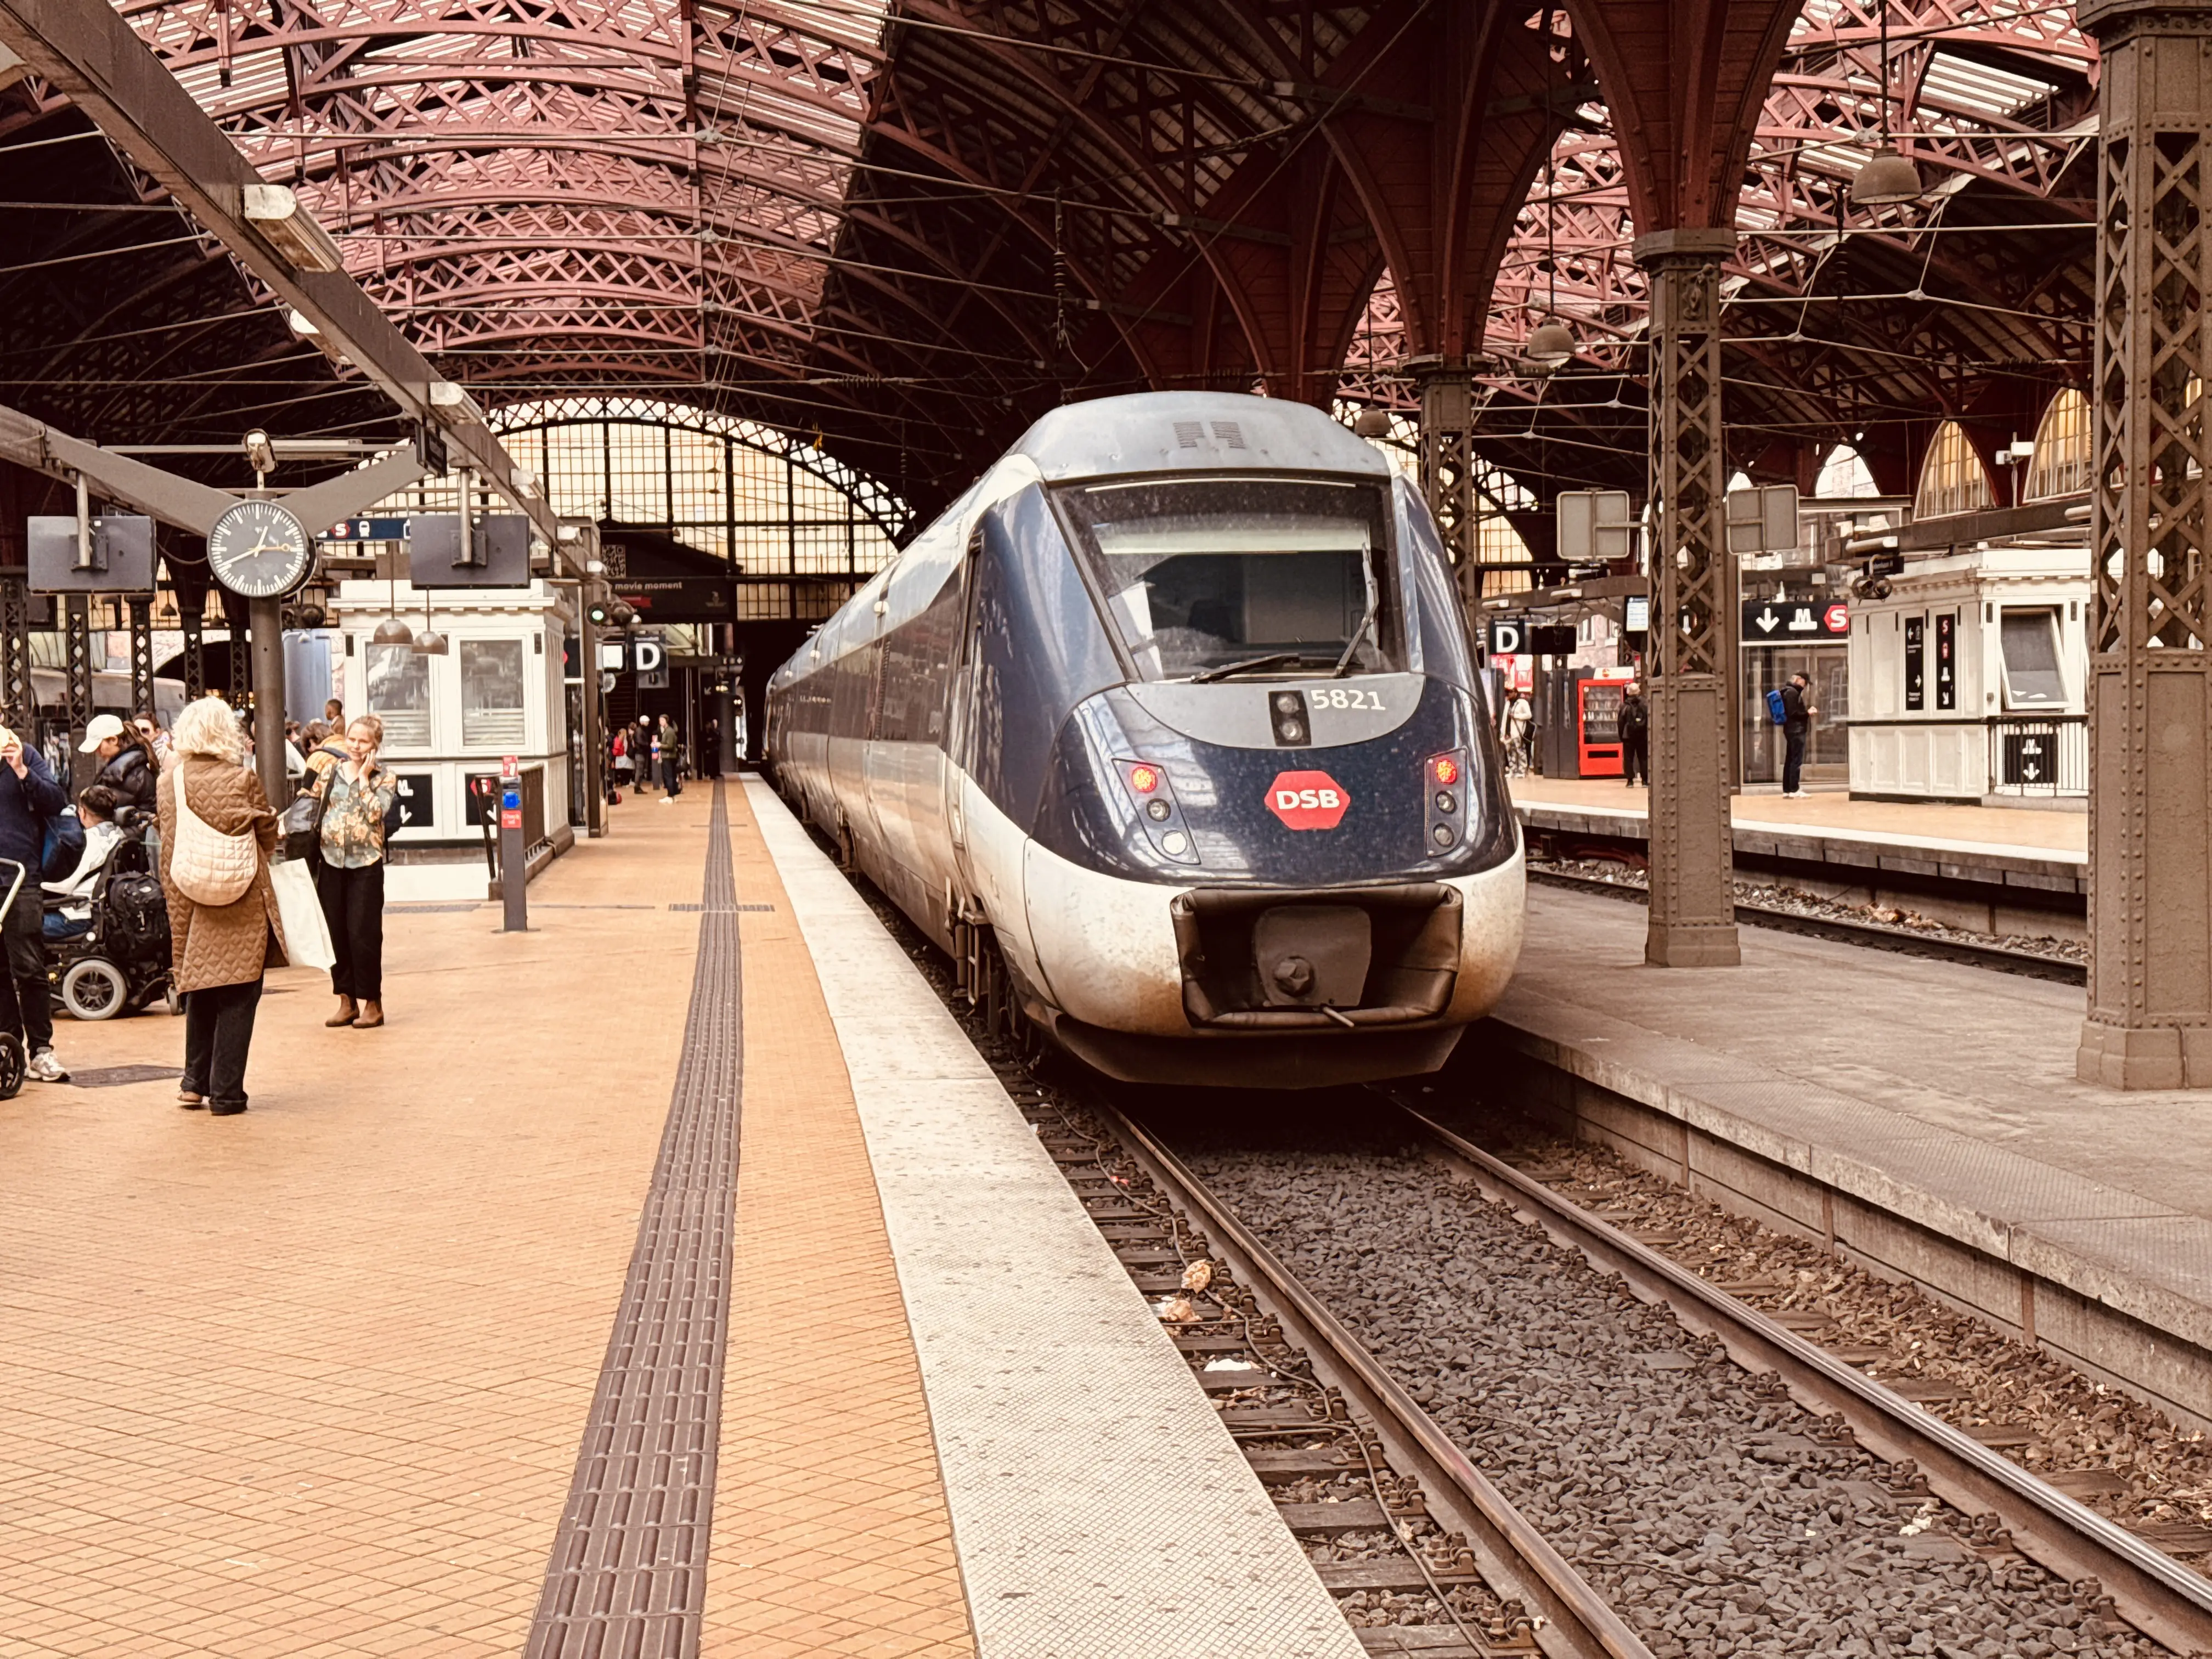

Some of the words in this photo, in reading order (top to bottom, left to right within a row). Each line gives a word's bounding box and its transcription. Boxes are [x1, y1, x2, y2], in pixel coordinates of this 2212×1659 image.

[614, 581, 642, 590] movie
[644, 581, 683, 590] moment
[1830, 609, 1847, 628] S
[1496, 626, 1519, 653] D
[635, 643, 660, 670] D
[1311, 689, 1386, 710] 5821
[1276, 789, 1340, 810] DSB
